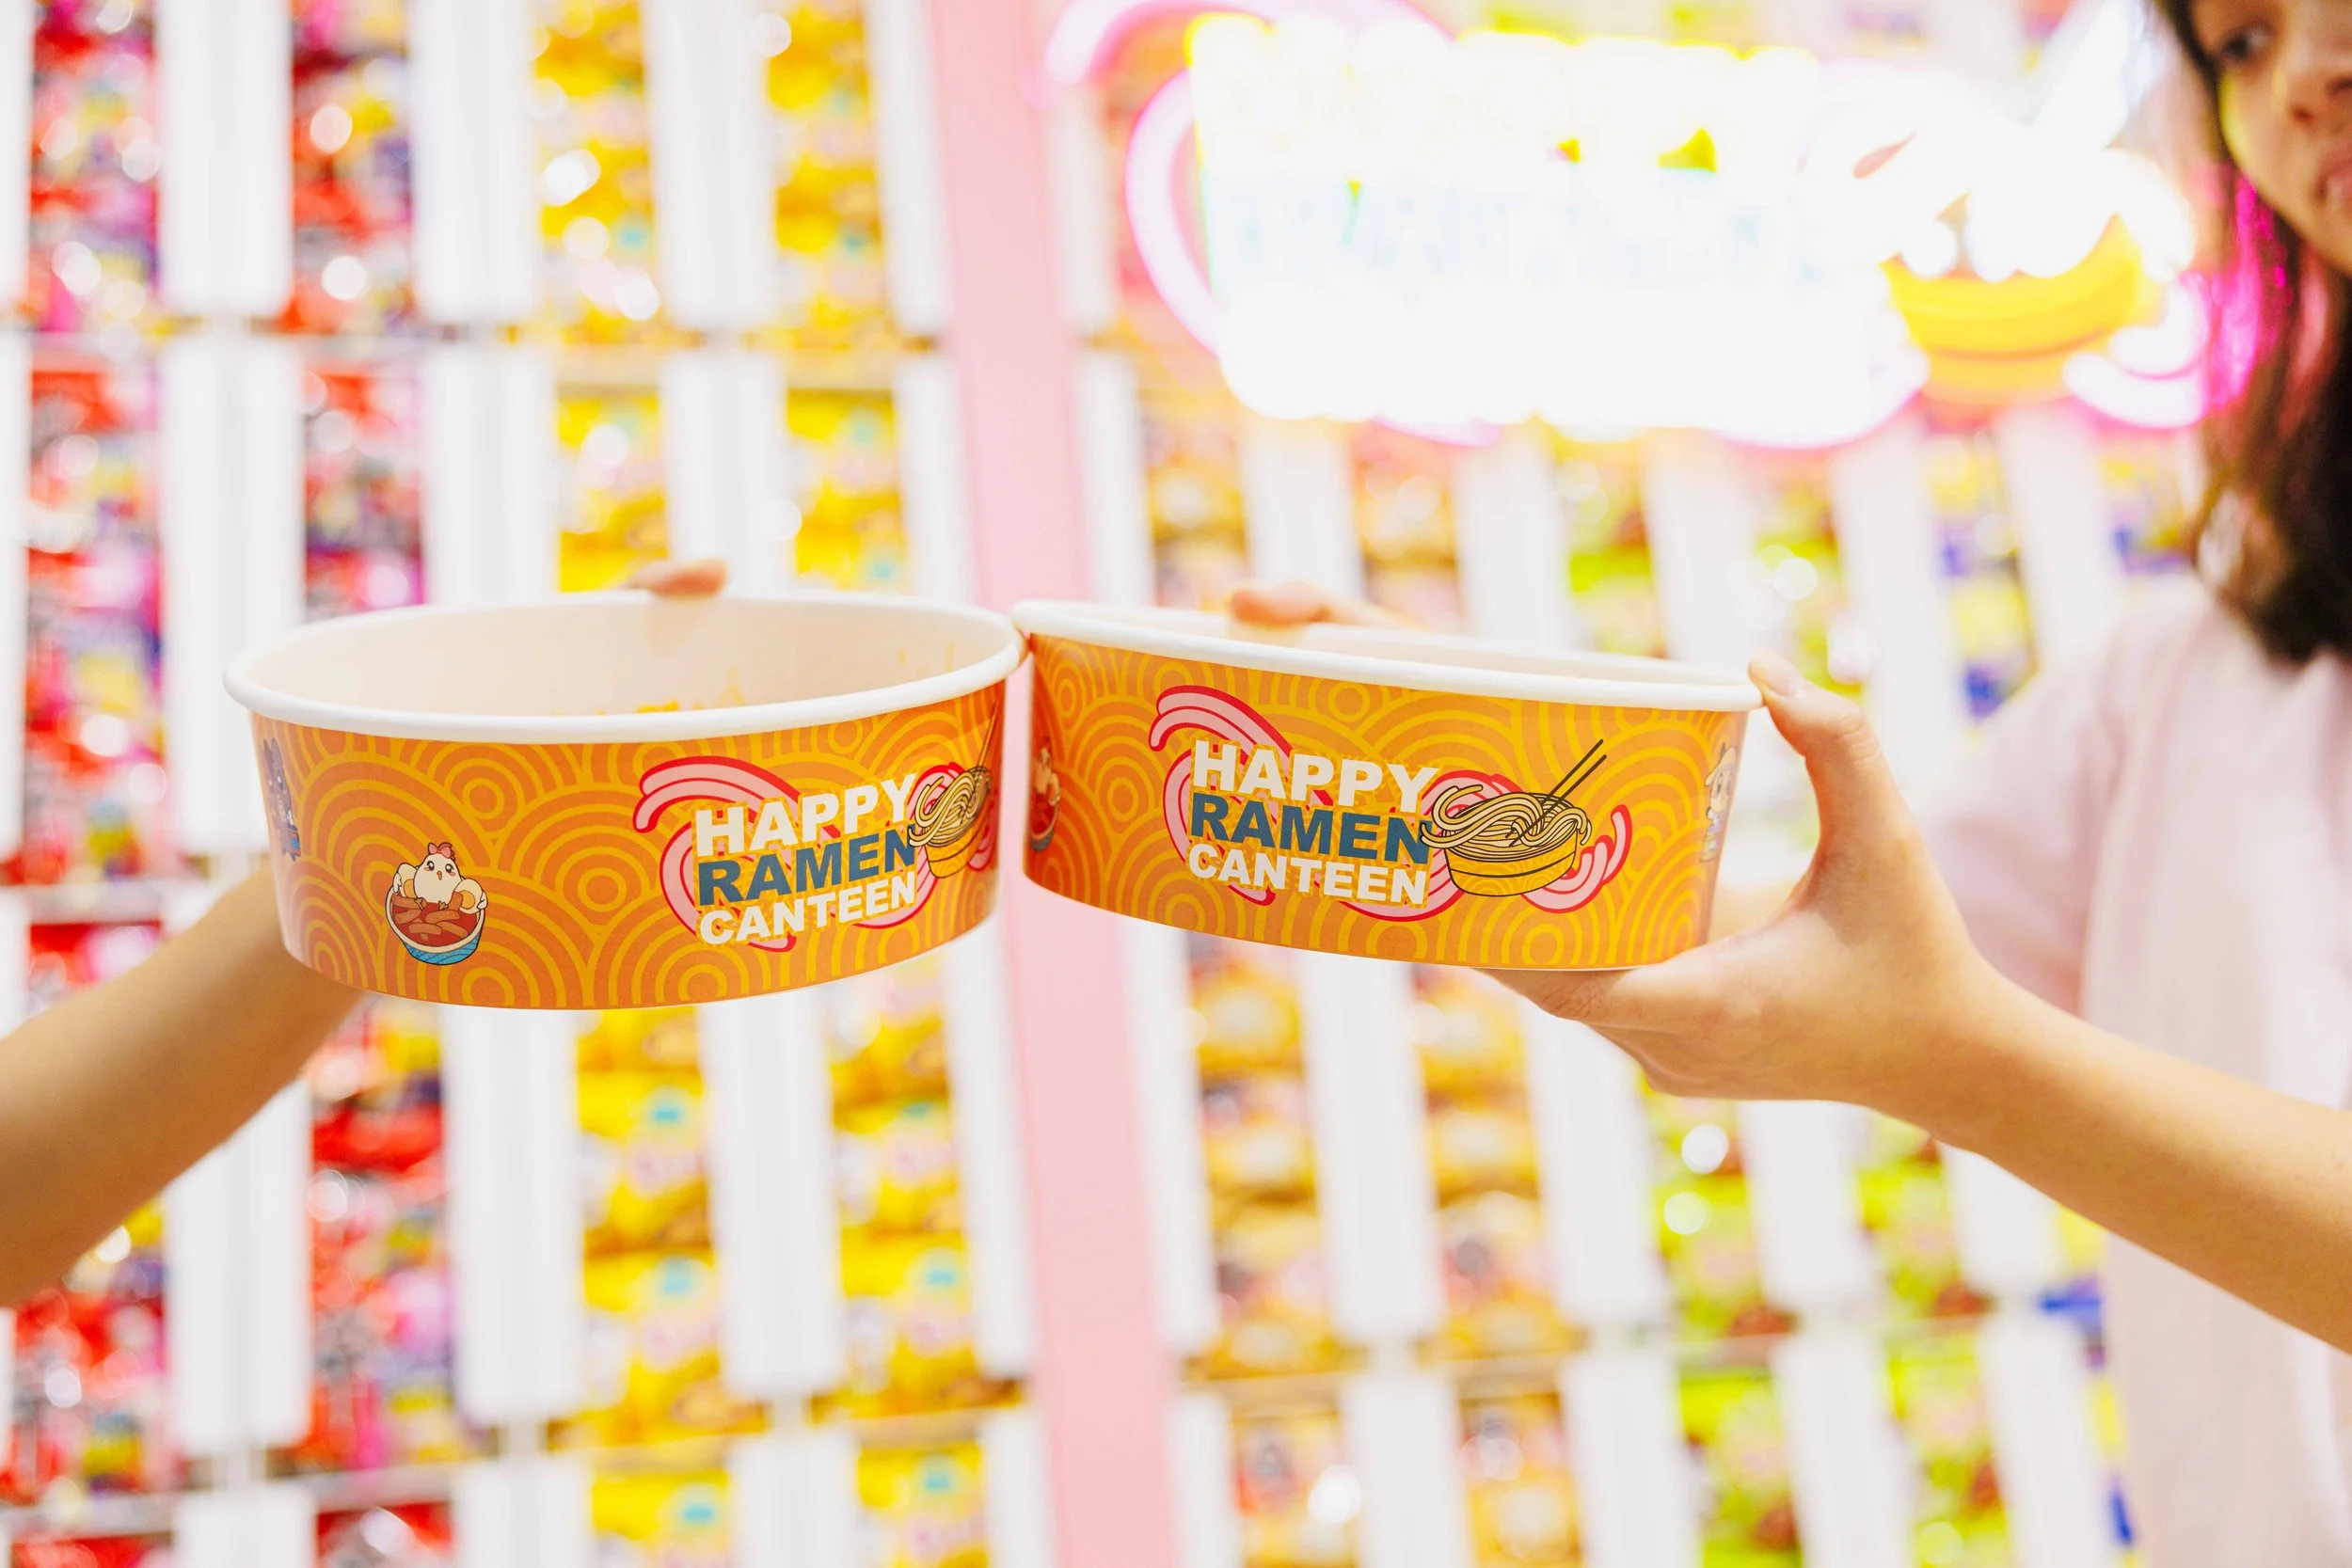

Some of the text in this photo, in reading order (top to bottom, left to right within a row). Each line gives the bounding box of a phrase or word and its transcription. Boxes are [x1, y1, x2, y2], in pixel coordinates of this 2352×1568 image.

[1193, 741, 1438, 813] HAPPY
[695, 774, 916, 857] HAPPY
[1190, 794, 1432, 863] RAMEN
[699, 824, 916, 906] RAMEN
[1189, 845, 1426, 905] CANTEEN
[700, 873, 916, 944] CANTEEN
